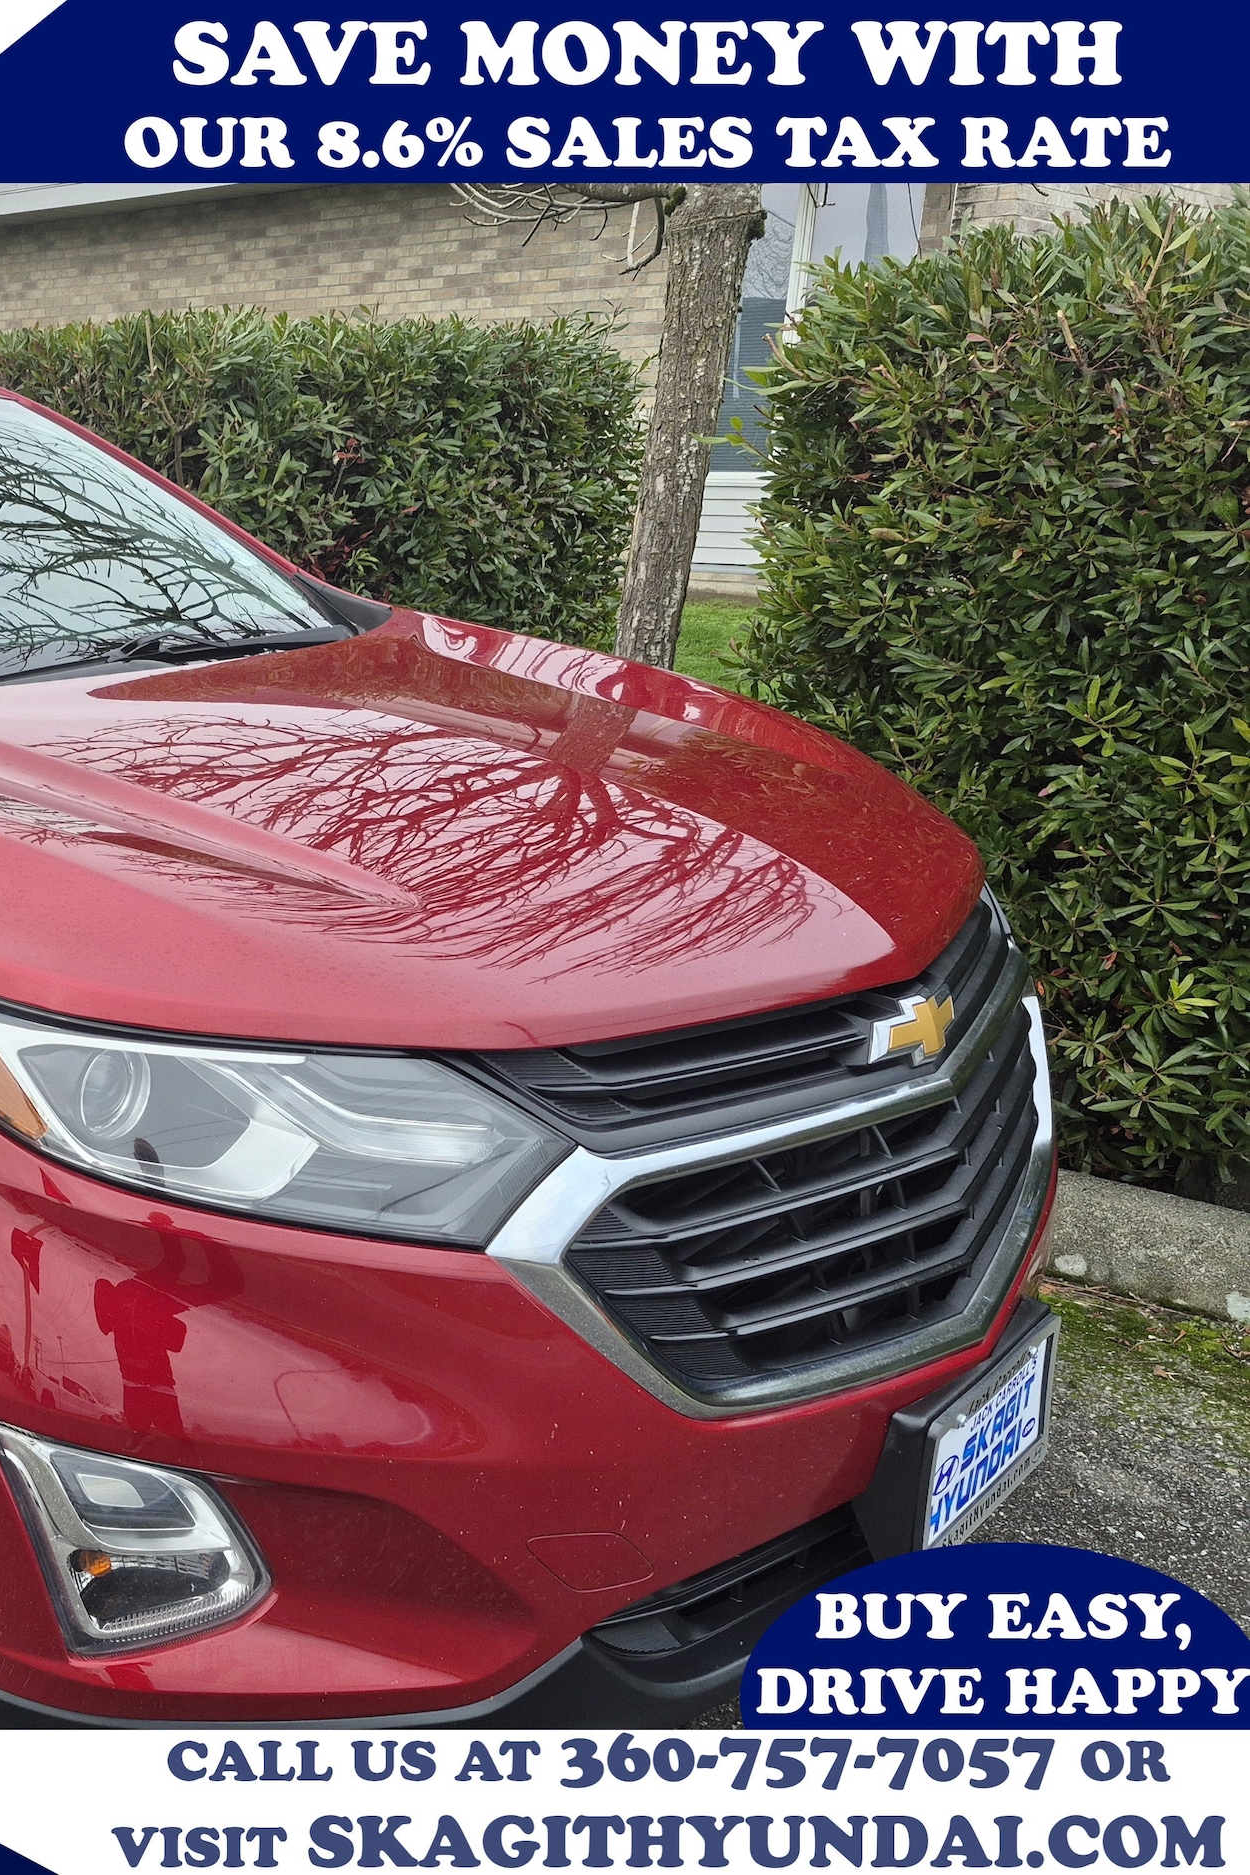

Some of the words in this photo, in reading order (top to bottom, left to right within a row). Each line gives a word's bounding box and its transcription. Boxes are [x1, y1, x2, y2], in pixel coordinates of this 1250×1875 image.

[960, 1373, 1036, 1474] SKAGIT
[971, 1400, 994, 1432] JACK
[930, 1418, 1022, 1533] HYUNDAI
